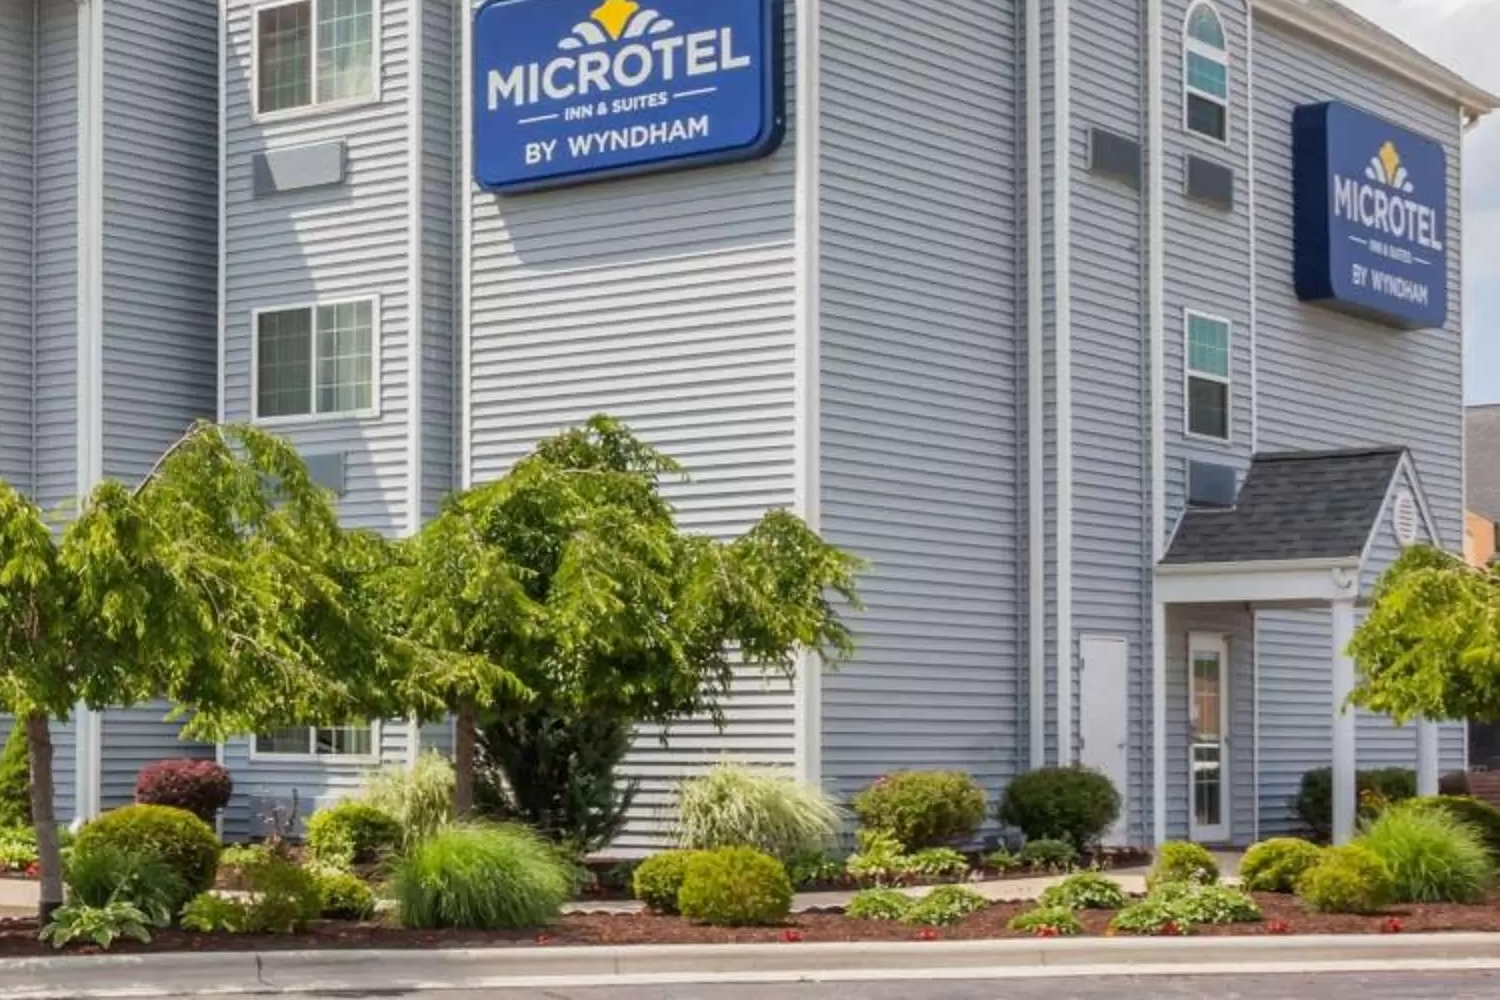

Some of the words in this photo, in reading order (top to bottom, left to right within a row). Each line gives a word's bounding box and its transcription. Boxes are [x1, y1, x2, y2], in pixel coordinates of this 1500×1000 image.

[487, 27, 750, 110] MICROTEL
[565, 105, 593, 121] INN
[597, 102, 607, 115] &
[612, 92, 668, 113] SUITES
[525, 139, 557, 165] BY
[568, 115, 709, 158] WYNDHAM
[1333, 174, 1443, 251] MICROTEL
[1352, 263, 1368, 286] BY
[1371, 269, 1428, 306] WYNDHAM
